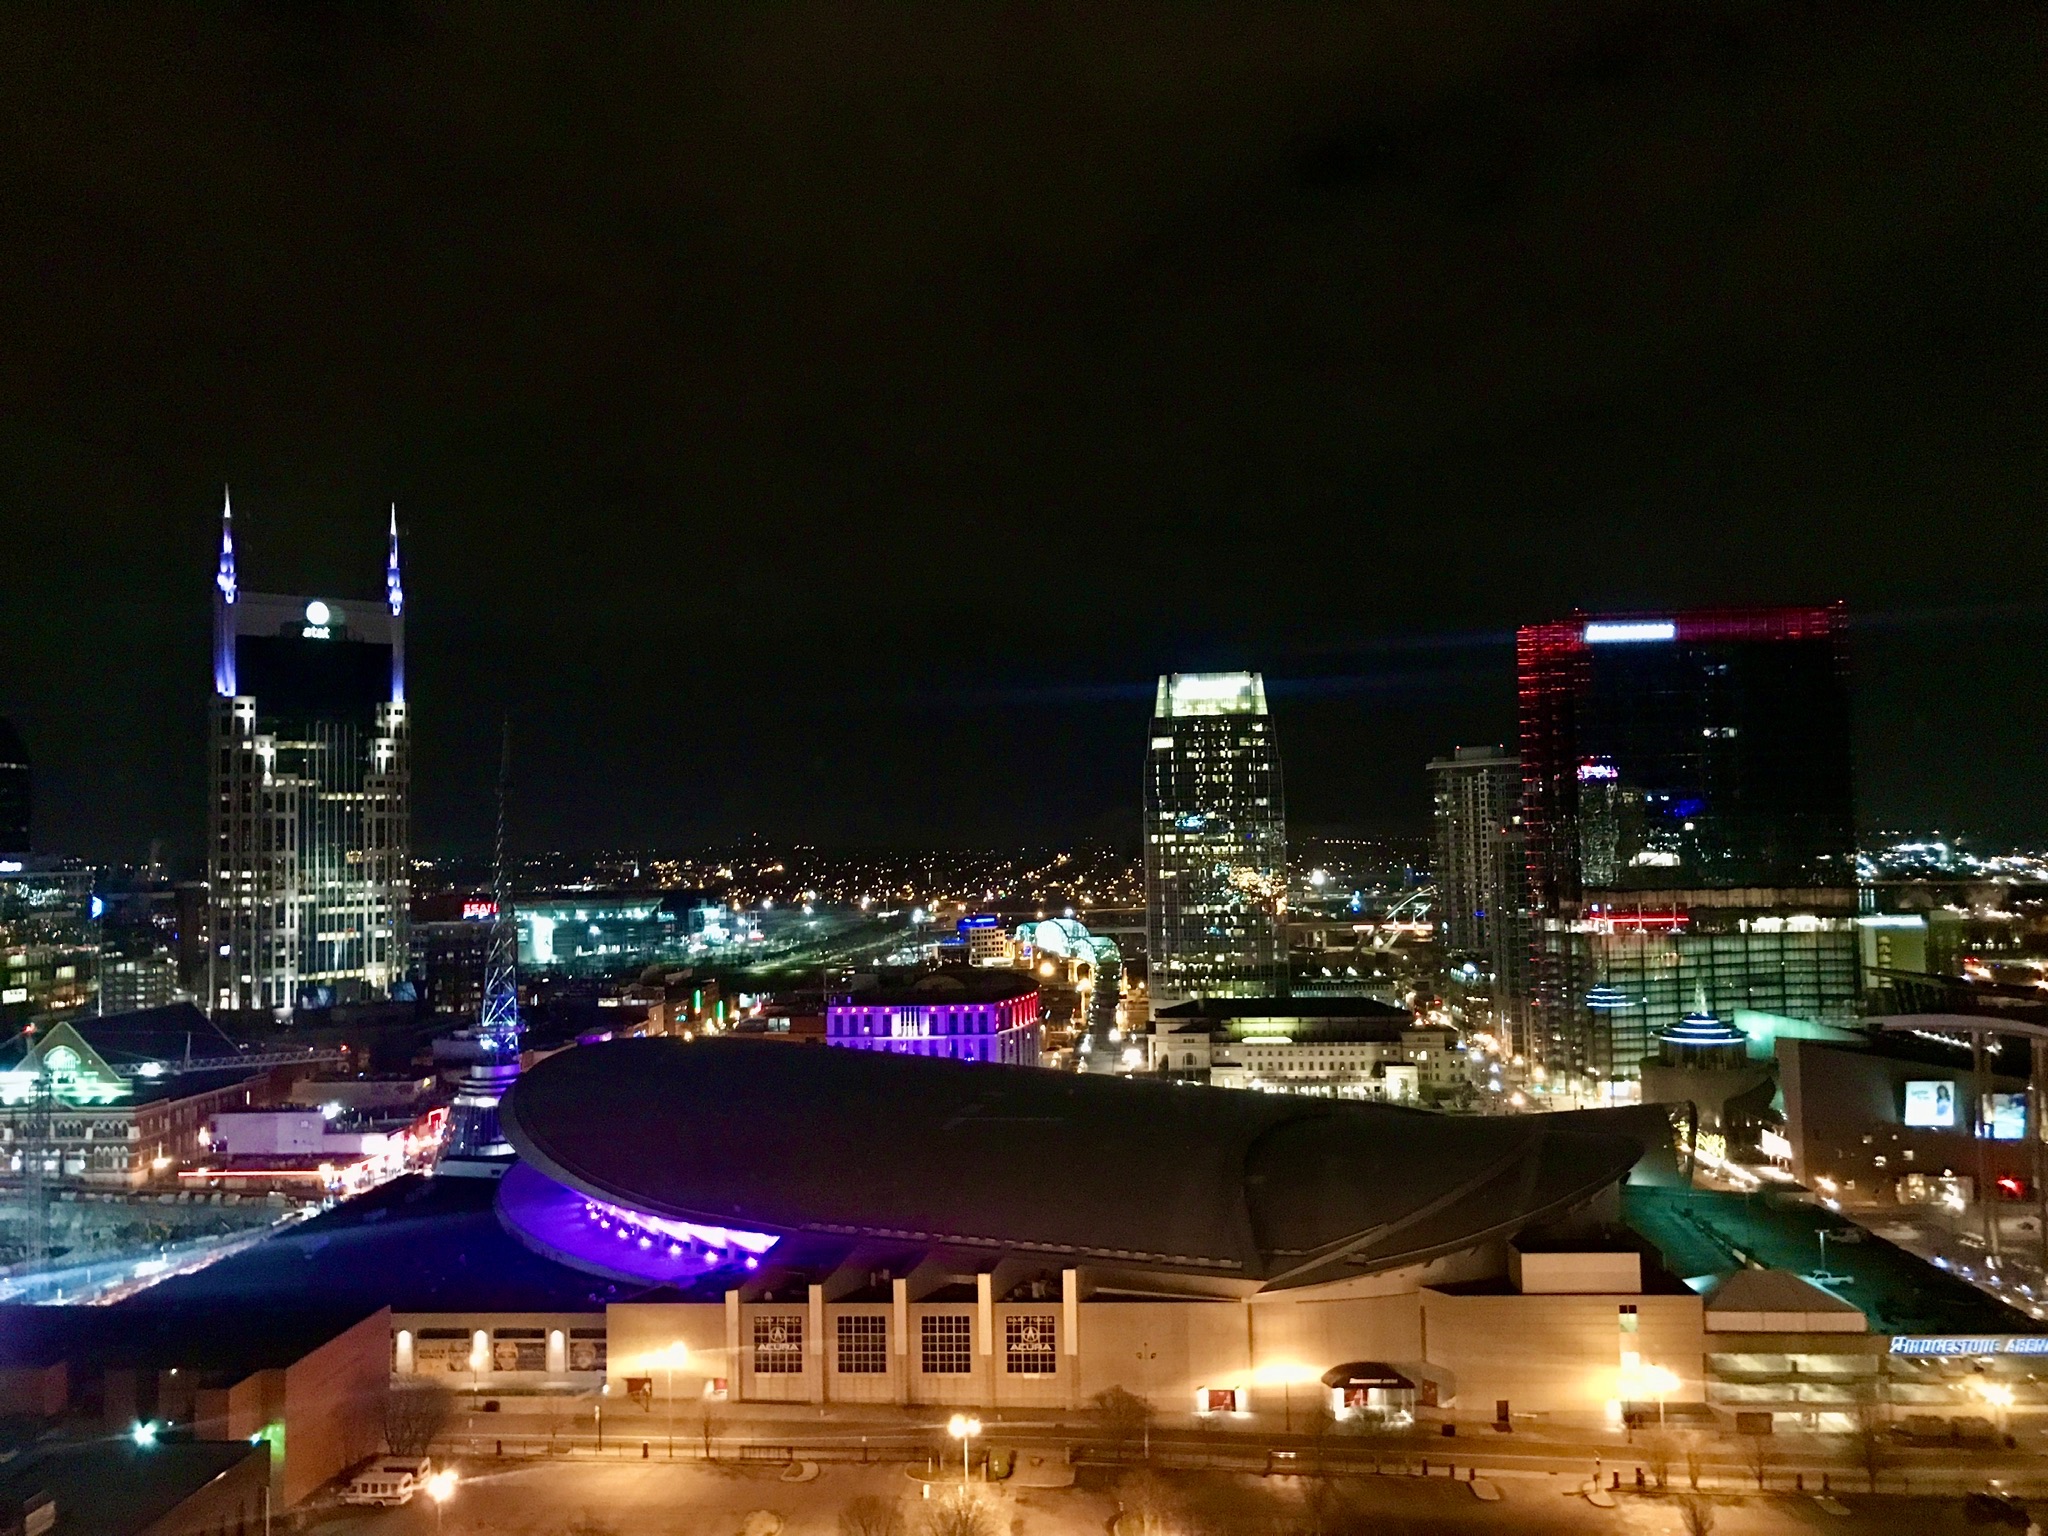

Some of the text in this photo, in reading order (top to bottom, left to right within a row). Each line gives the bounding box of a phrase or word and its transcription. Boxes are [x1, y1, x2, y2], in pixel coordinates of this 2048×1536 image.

[757, 1343, 799, 1351] ACURA
[1010, 1343, 1052, 1351] ACURA
[1889, 1336, 2001, 1353] BRIDGESTONE
